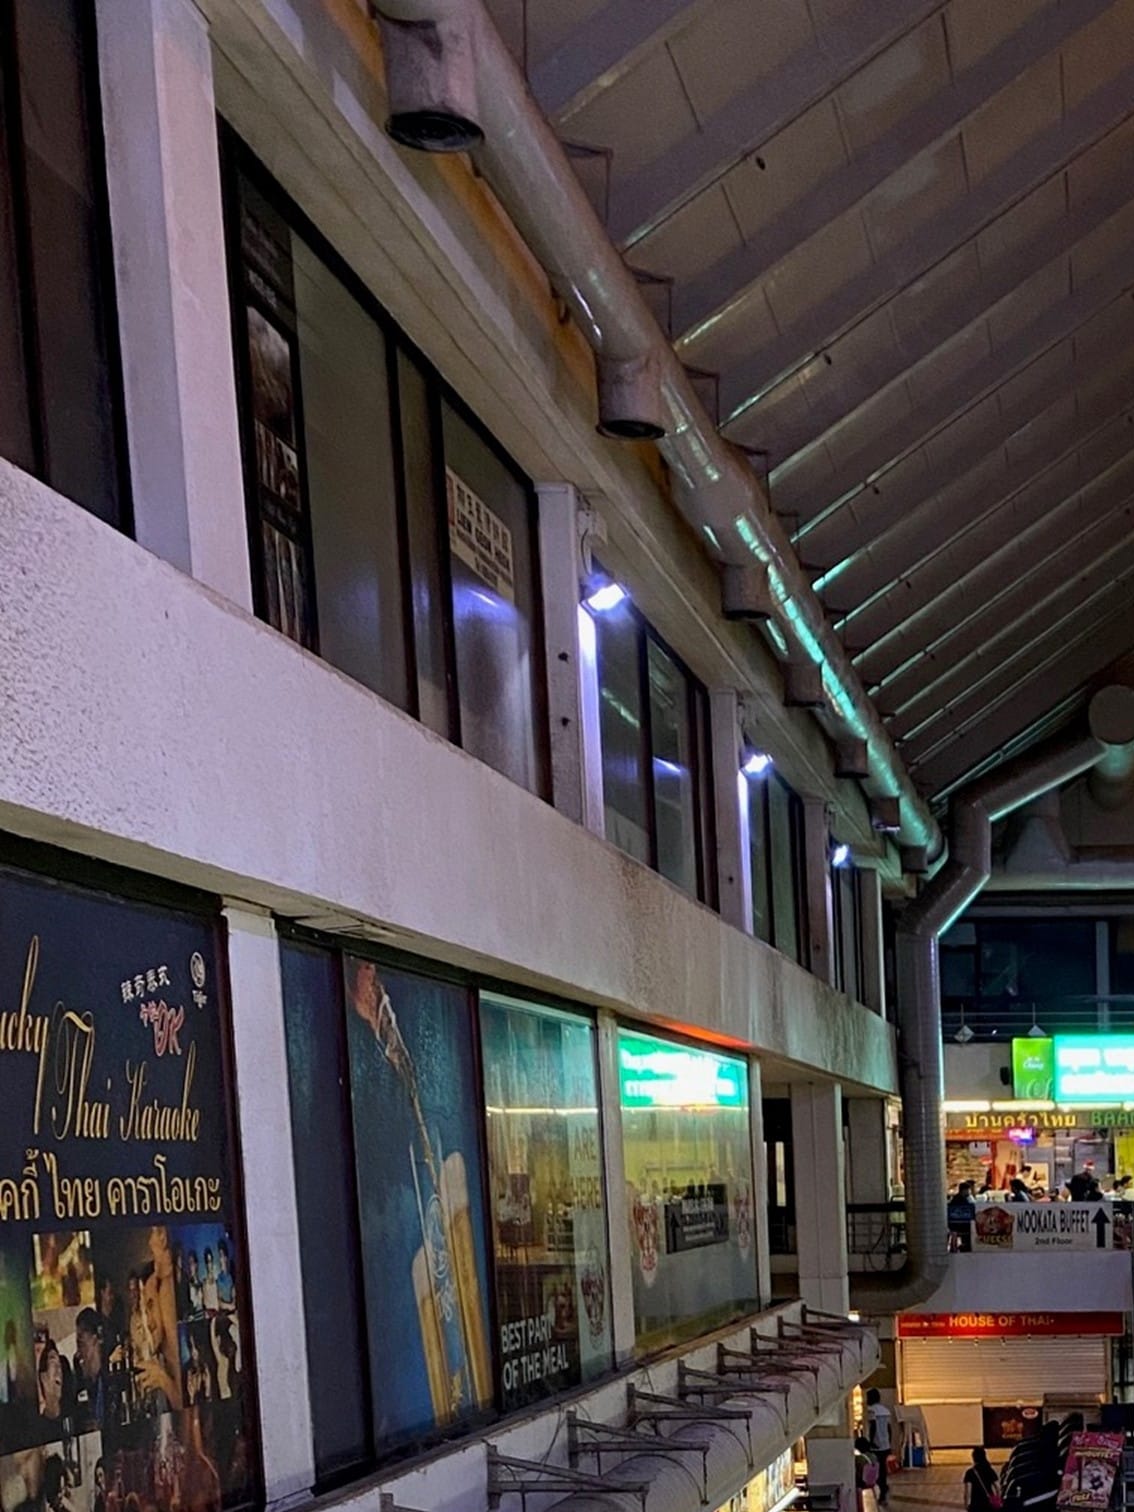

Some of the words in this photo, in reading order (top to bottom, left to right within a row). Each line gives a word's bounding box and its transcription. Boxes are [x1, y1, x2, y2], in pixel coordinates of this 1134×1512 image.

[51, 1000, 111, 1141] Thai
[119, 1040, 202, 1142] Karaoke
[42, 1152, 100, 1219] ไทย
[1016, 1209, 1058, 1234] MOOKATA
[1059, 1209, 1090, 1234] BUFFET
[1051, 1237, 1073, 1246] Floor
[501, 1319, 526, 1354] BEST
[949, 1314, 995, 1328] HOUSE
[998, 1315, 1016, 1328] OF
[503, 1358, 519, 1391] OF
[520, 1352, 541, 1384] THE
[541, 1343, 570, 1377] MEAL
